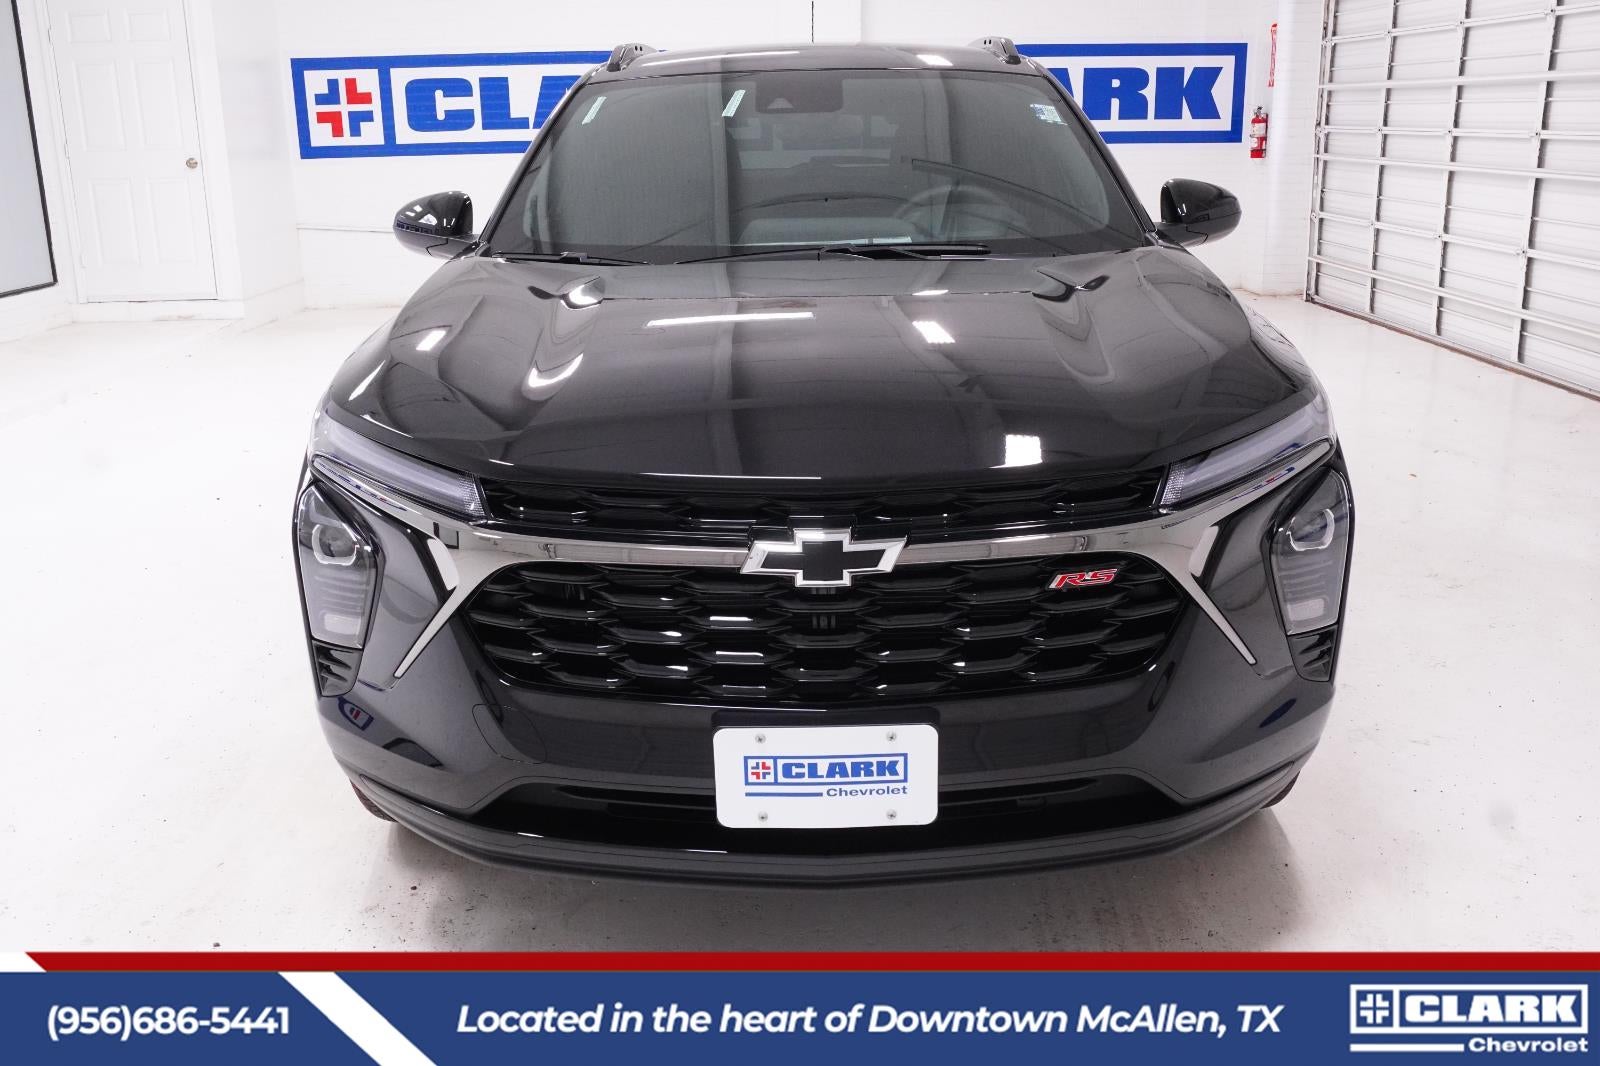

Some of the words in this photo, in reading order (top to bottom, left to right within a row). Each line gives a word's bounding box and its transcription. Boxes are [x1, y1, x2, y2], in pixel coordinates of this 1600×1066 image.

[1049, 568, 1118, 589] RS
[782, 760, 900, 779] CLARK
[826, 785, 908, 797] Chevrolet
